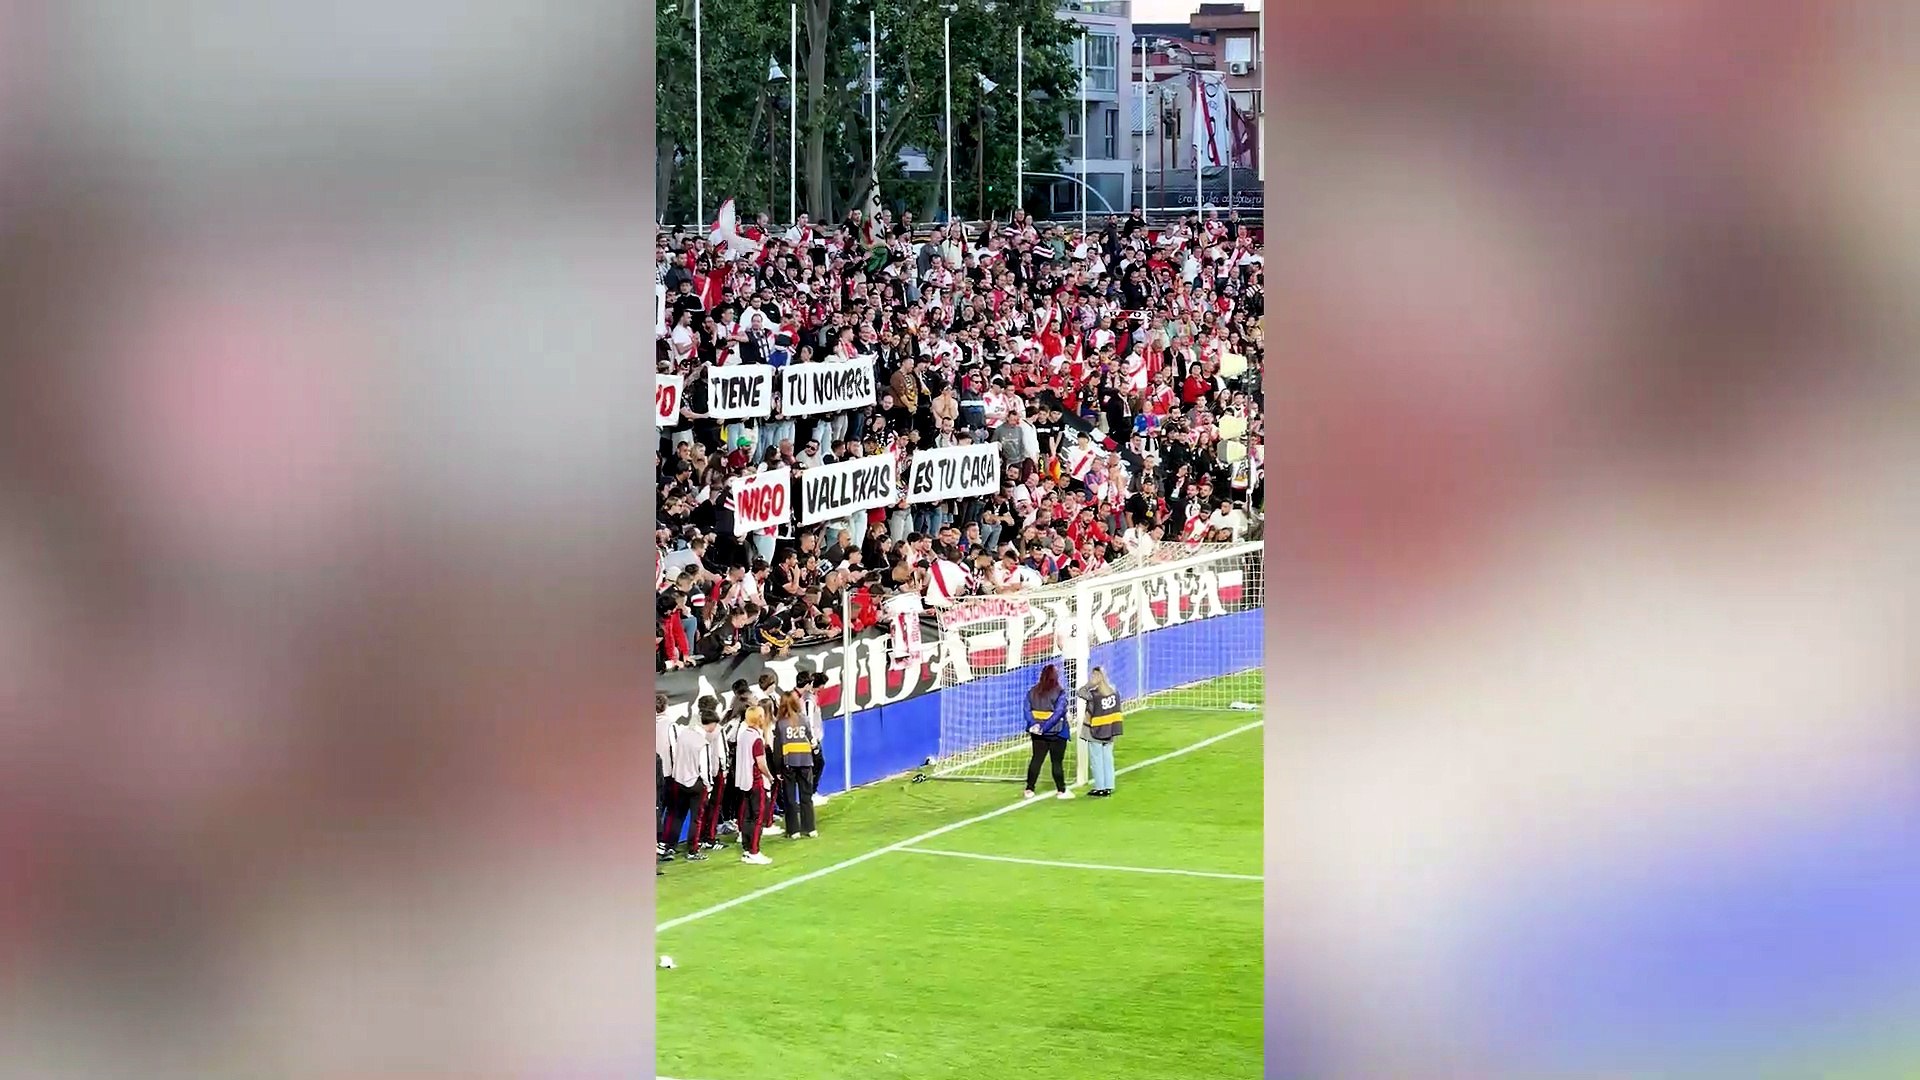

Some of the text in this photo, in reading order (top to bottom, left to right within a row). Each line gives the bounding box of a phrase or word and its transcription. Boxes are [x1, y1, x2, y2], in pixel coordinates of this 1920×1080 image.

[711, 375, 764, 409] TIENE
[788, 366, 871, 405] TU NOMBRE
[913, 454, 995, 494] ES TU CASA
[738, 476, 785, 523] IÑIGO
[786, 725, 806, 739] 926
